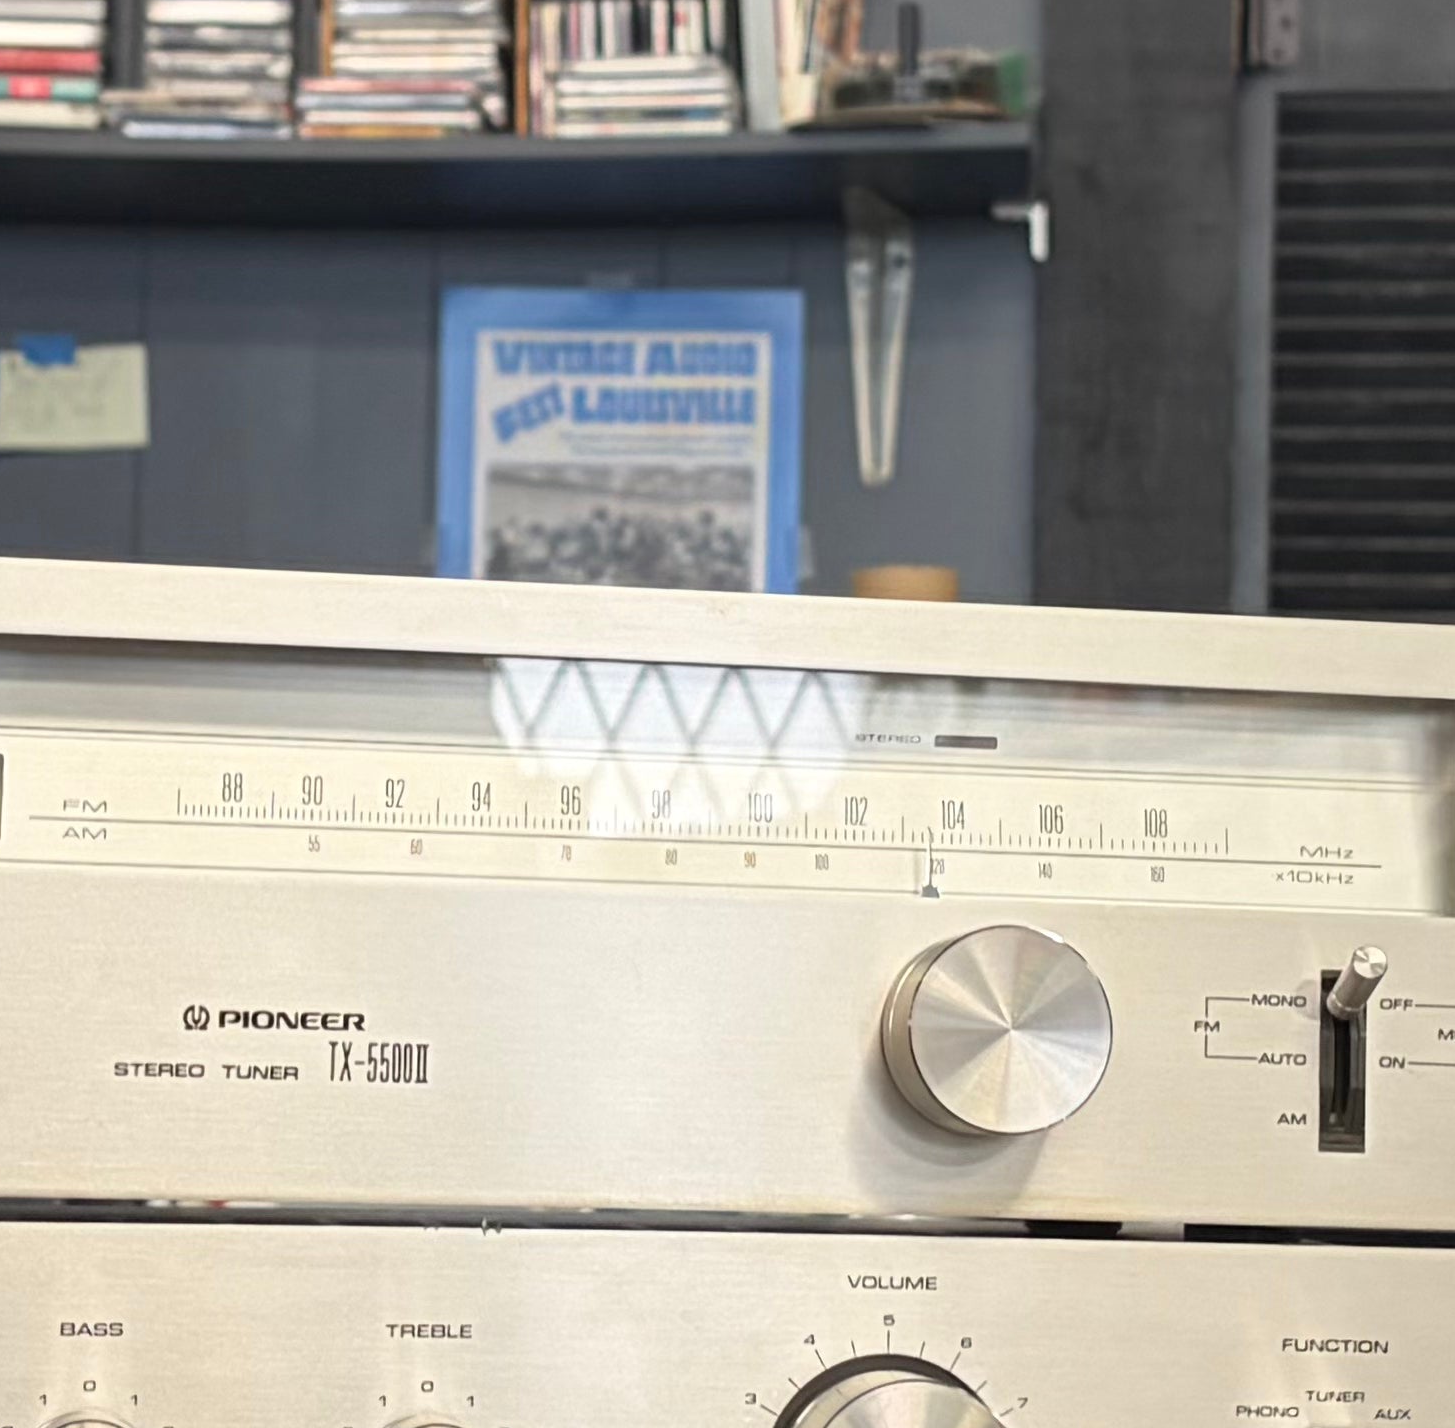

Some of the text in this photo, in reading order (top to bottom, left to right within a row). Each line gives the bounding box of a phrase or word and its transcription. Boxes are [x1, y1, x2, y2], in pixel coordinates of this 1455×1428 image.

[855, 733, 921, 745] STEREO
[62, 772, 1354, 860] FM 88 90 92 94 96 98 100 102 104 106 108 MHz
[62, 826, 108, 841] AM
[744, 851, 757, 869] 90
[814, 853, 829, 871] 100
[1038, 862, 1053, 879] 140
[1150, 866, 1165, 883] 160
[1275, 868, 1355, 886] x10kHz
[1251, 993, 1307, 1007] MONO
[1379, 998, 1413, 1011] OFF
[218, 1010, 366, 1031] PIONEER
[1193, 1020, 1220, 1033] FM
[1258, 1053, 1307, 1066] AUTO
[1379, 1056, 1406, 1069] ON
[114, 1061, 205, 1079] STEREO
[222, 1064, 299, 1081] TUNER
[1277, 1113, 1307, 1125] AM
[848, 1275, 938, 1291] VOLUME
[883, 1314, 895, 1326] 5
[60, 1322, 124, 1337] BASS
[386, 1323, 473, 1339] TREBLE
[803, 1334, 815, 1346] 4
[960, 1336, 972, 1349] 6
[1281, 1337, 1389, 1354] FUNCTION
[38, 1394, 48, 1407] 1
[130, 1394, 139, 1407] 1
[378, 1395, 387, 1407] 1
[466, 1395, 475, 1408] 1
[744, 1393, 756, 1406] 3
[1305, 1389, 1365, 1403] TUNER
[1017, 1397, 1029, 1409] 7
[1235, 1404, 1300, 1418] PHONO
[1374, 1408, 1412, 1421] AUX
